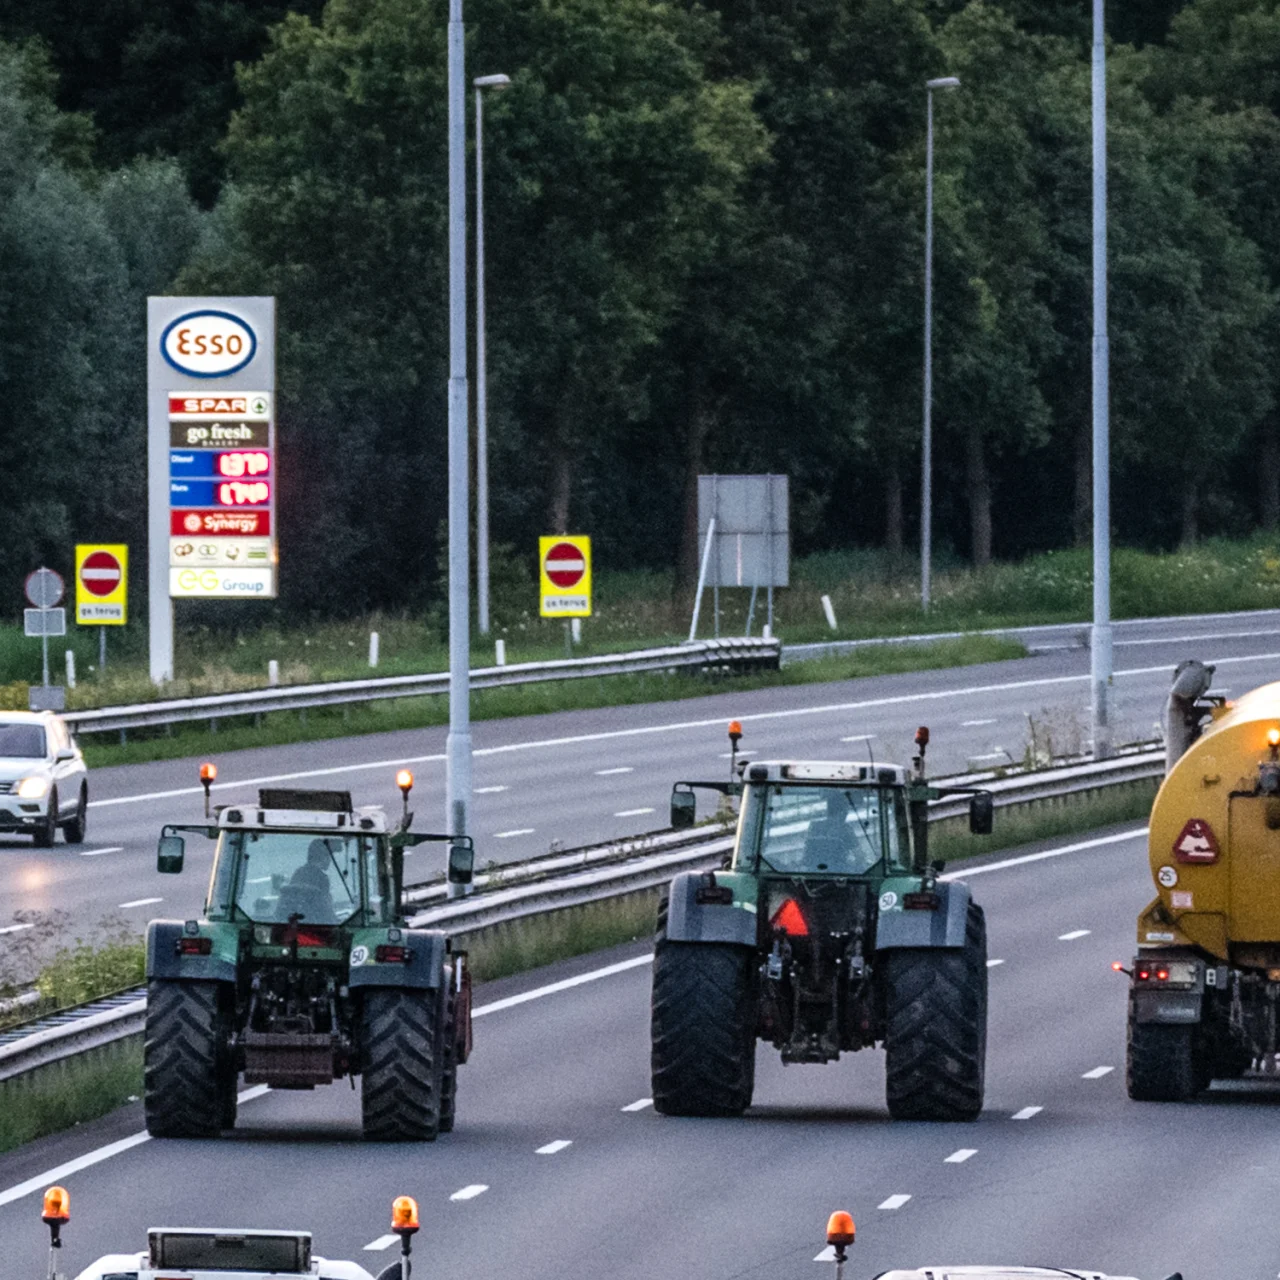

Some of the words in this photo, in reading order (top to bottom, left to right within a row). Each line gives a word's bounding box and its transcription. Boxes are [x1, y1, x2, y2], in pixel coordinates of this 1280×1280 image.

[176, 328, 243, 356] Esso
[183, 398, 246, 412] SPAR
[186, 427, 209, 444] go
[211, 423, 252, 439] fresh
[204, 515, 258, 532] Synergy
[222, 578, 264, 592] Group
[81, 607, 92, 616] ga
[95, 607, 121, 616] terug
[352, 948, 365, 964] 50
